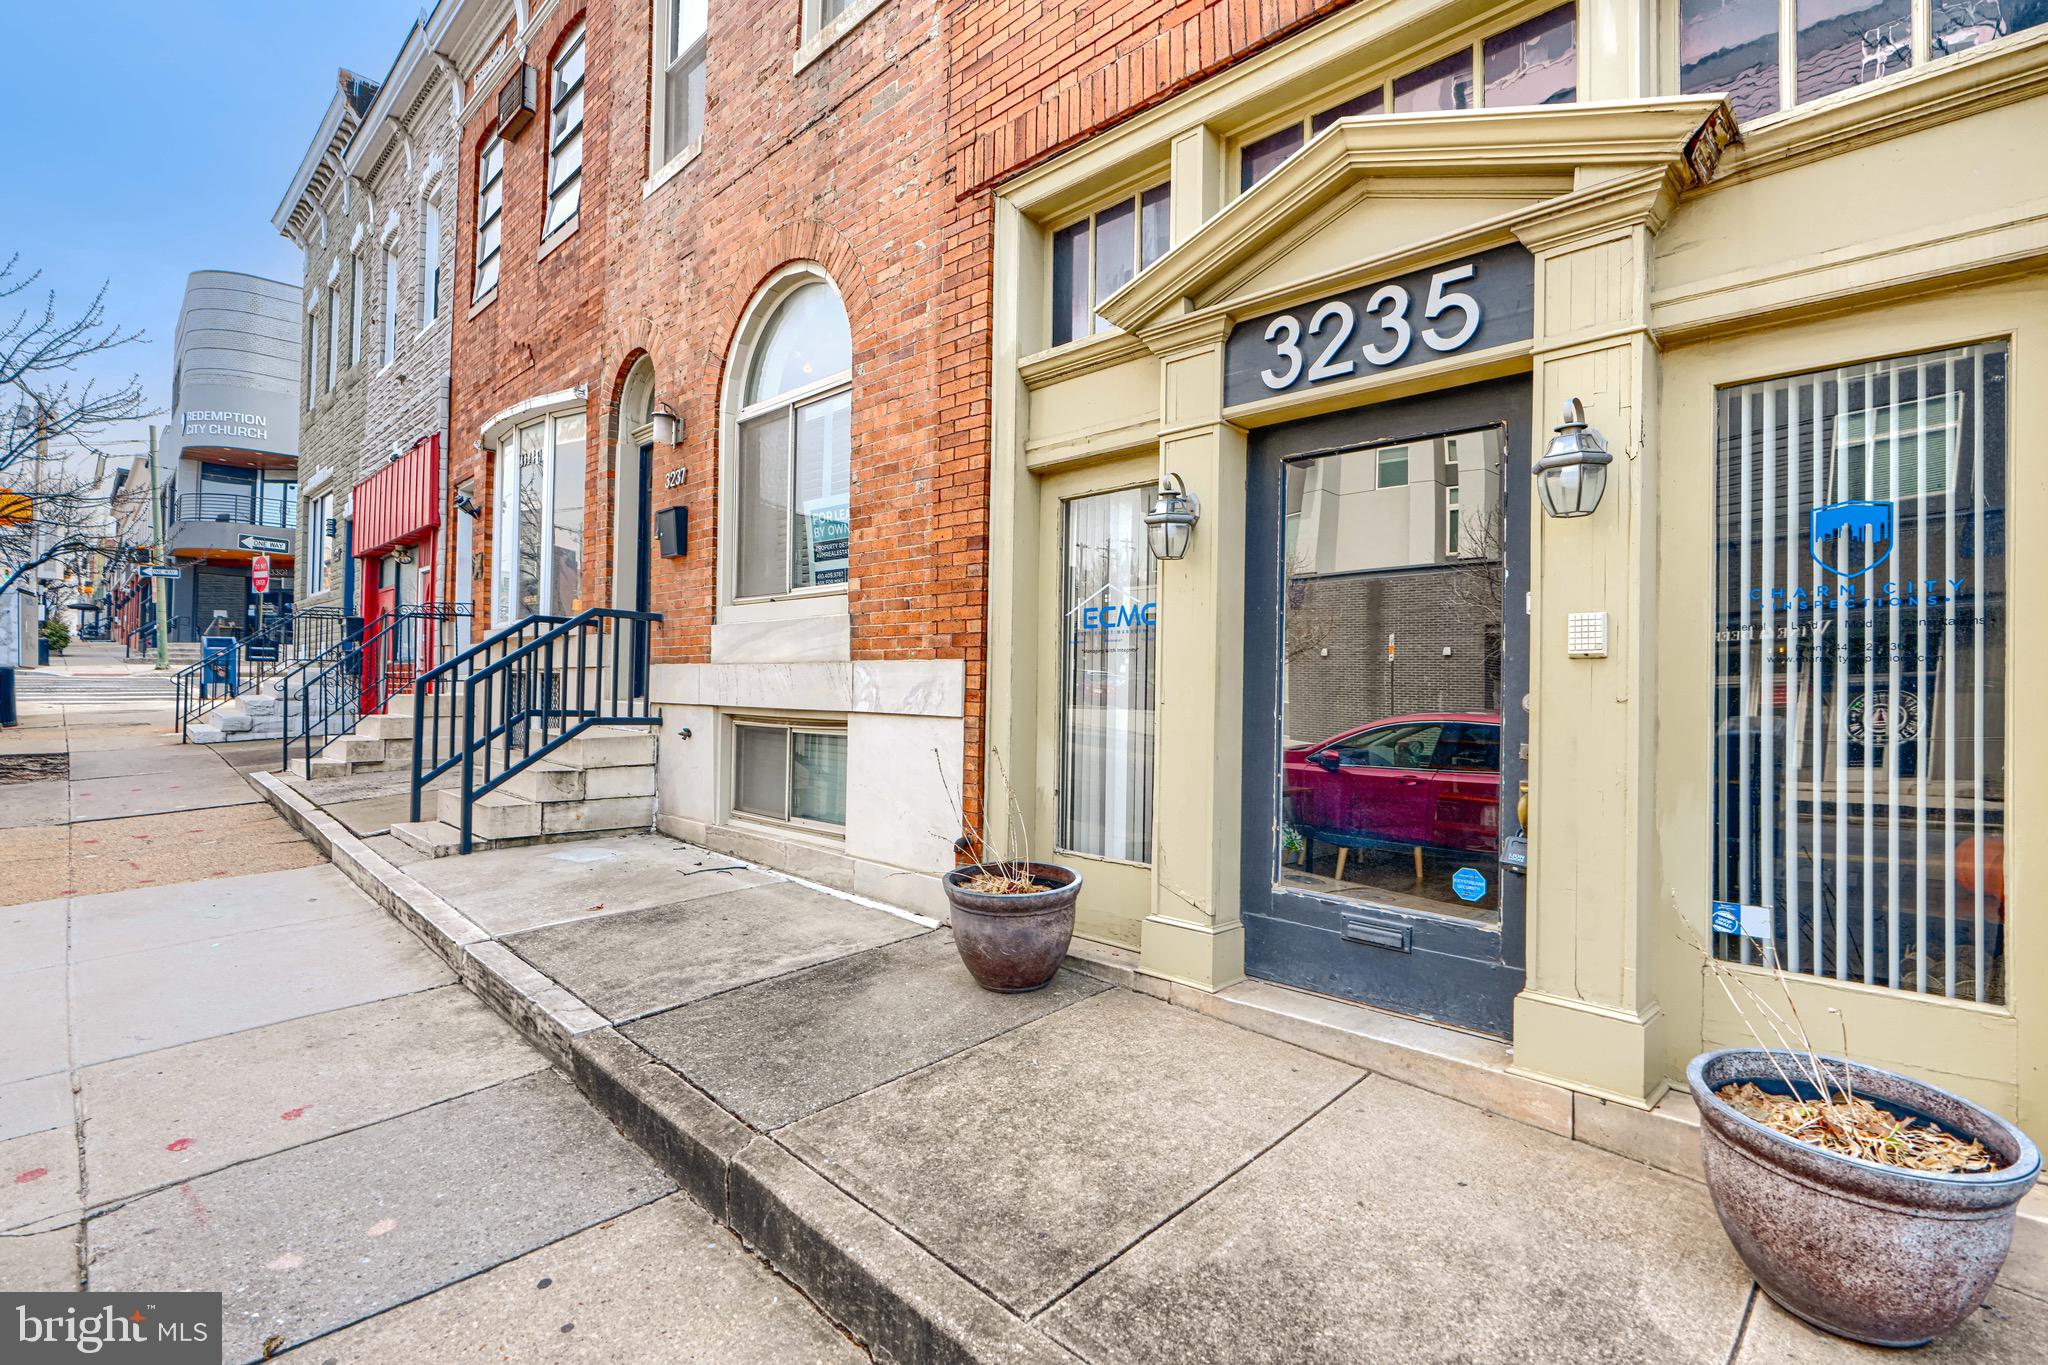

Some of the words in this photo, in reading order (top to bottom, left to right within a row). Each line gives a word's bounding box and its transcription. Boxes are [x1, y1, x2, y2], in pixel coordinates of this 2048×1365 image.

[1261, 263, 1481, 391] 3235
[187, 410, 267, 427] REDEMPTION
[186, 423, 206, 435] CITY
[208, 424, 267, 440] CHURCH
[664, 467, 688, 489] 3237
[813, 510, 833, 526] FOR
[813, 526, 826, 538] BY
[1749, 583, 1857, 600] CHARM
[1883, 578, 1967, 594] CITY
[1772, 595, 1937, 610] INSPECTIONS
